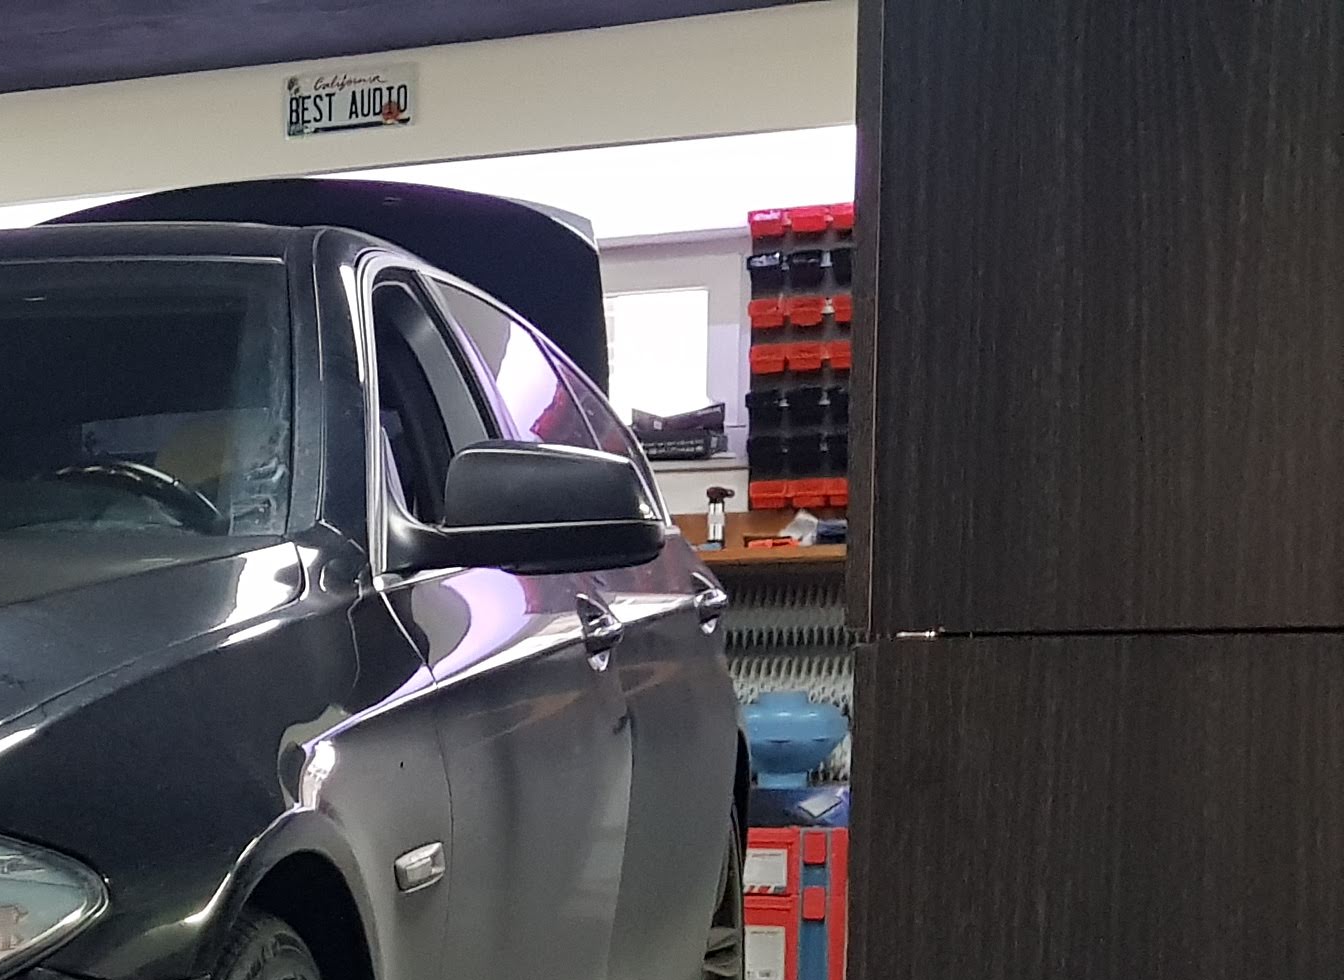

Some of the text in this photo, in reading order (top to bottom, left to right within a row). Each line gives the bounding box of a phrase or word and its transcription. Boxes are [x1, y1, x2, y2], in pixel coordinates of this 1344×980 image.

[314, 74, 385, 91] California
[289, 84, 408, 125] BEST AUDIO
